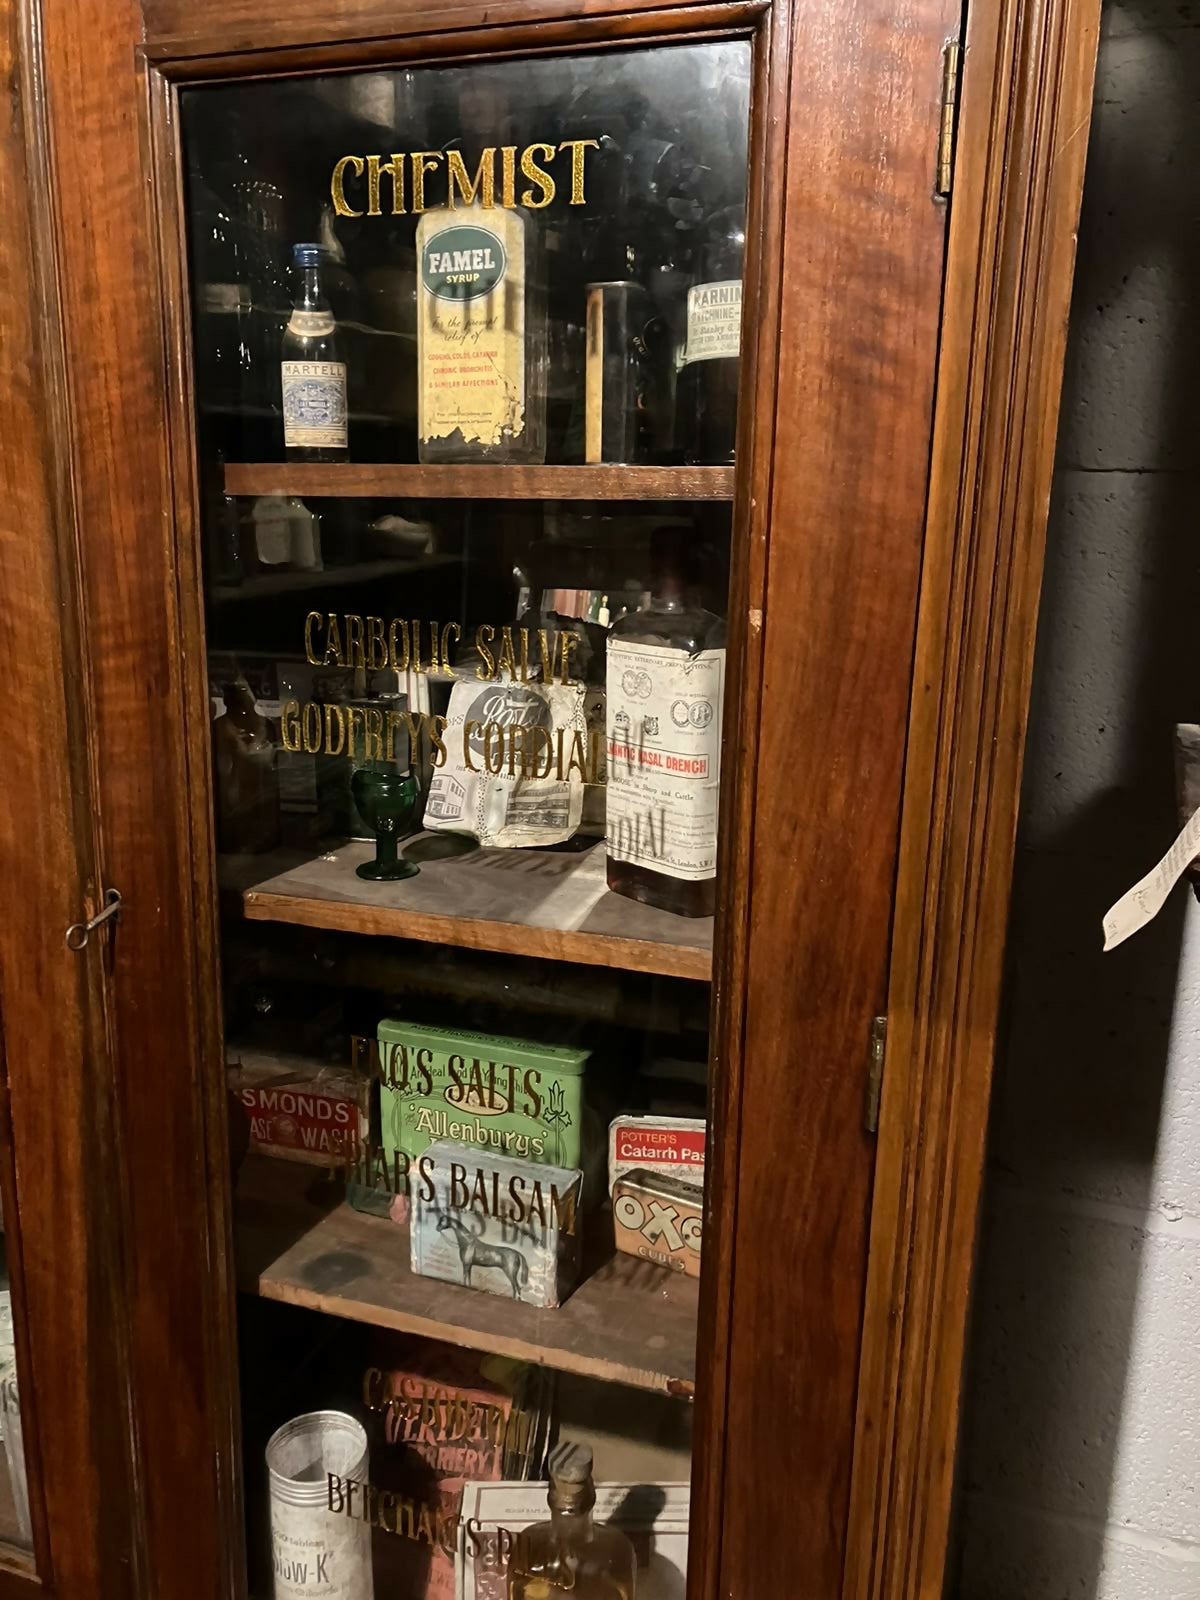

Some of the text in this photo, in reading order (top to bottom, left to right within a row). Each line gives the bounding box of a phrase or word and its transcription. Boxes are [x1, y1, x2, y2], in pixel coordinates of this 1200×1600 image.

[331, 139, 600, 217] CHEMIST
[429, 248, 496, 274] FAMEL
[446, 273, 480, 284] SYRUP
[284, 365, 343, 376] MARTELL
[304, 611, 582, 686] CARBOLIC SALVE
[464, 719, 606, 784] CORDIAL
[638, 750, 664, 768] NASAL
[666, 756, 707, 774] DRENCH
[674, 791, 694, 801] Cattle
[447, 1054, 542, 1119] SALTS
[621, 1131, 677, 1145] POTTER'S
[621, 1143, 677, 1160] Catarrh
[450, 1162, 577, 1236] BALSAM
[615, 1195, 703, 1252] OXO
